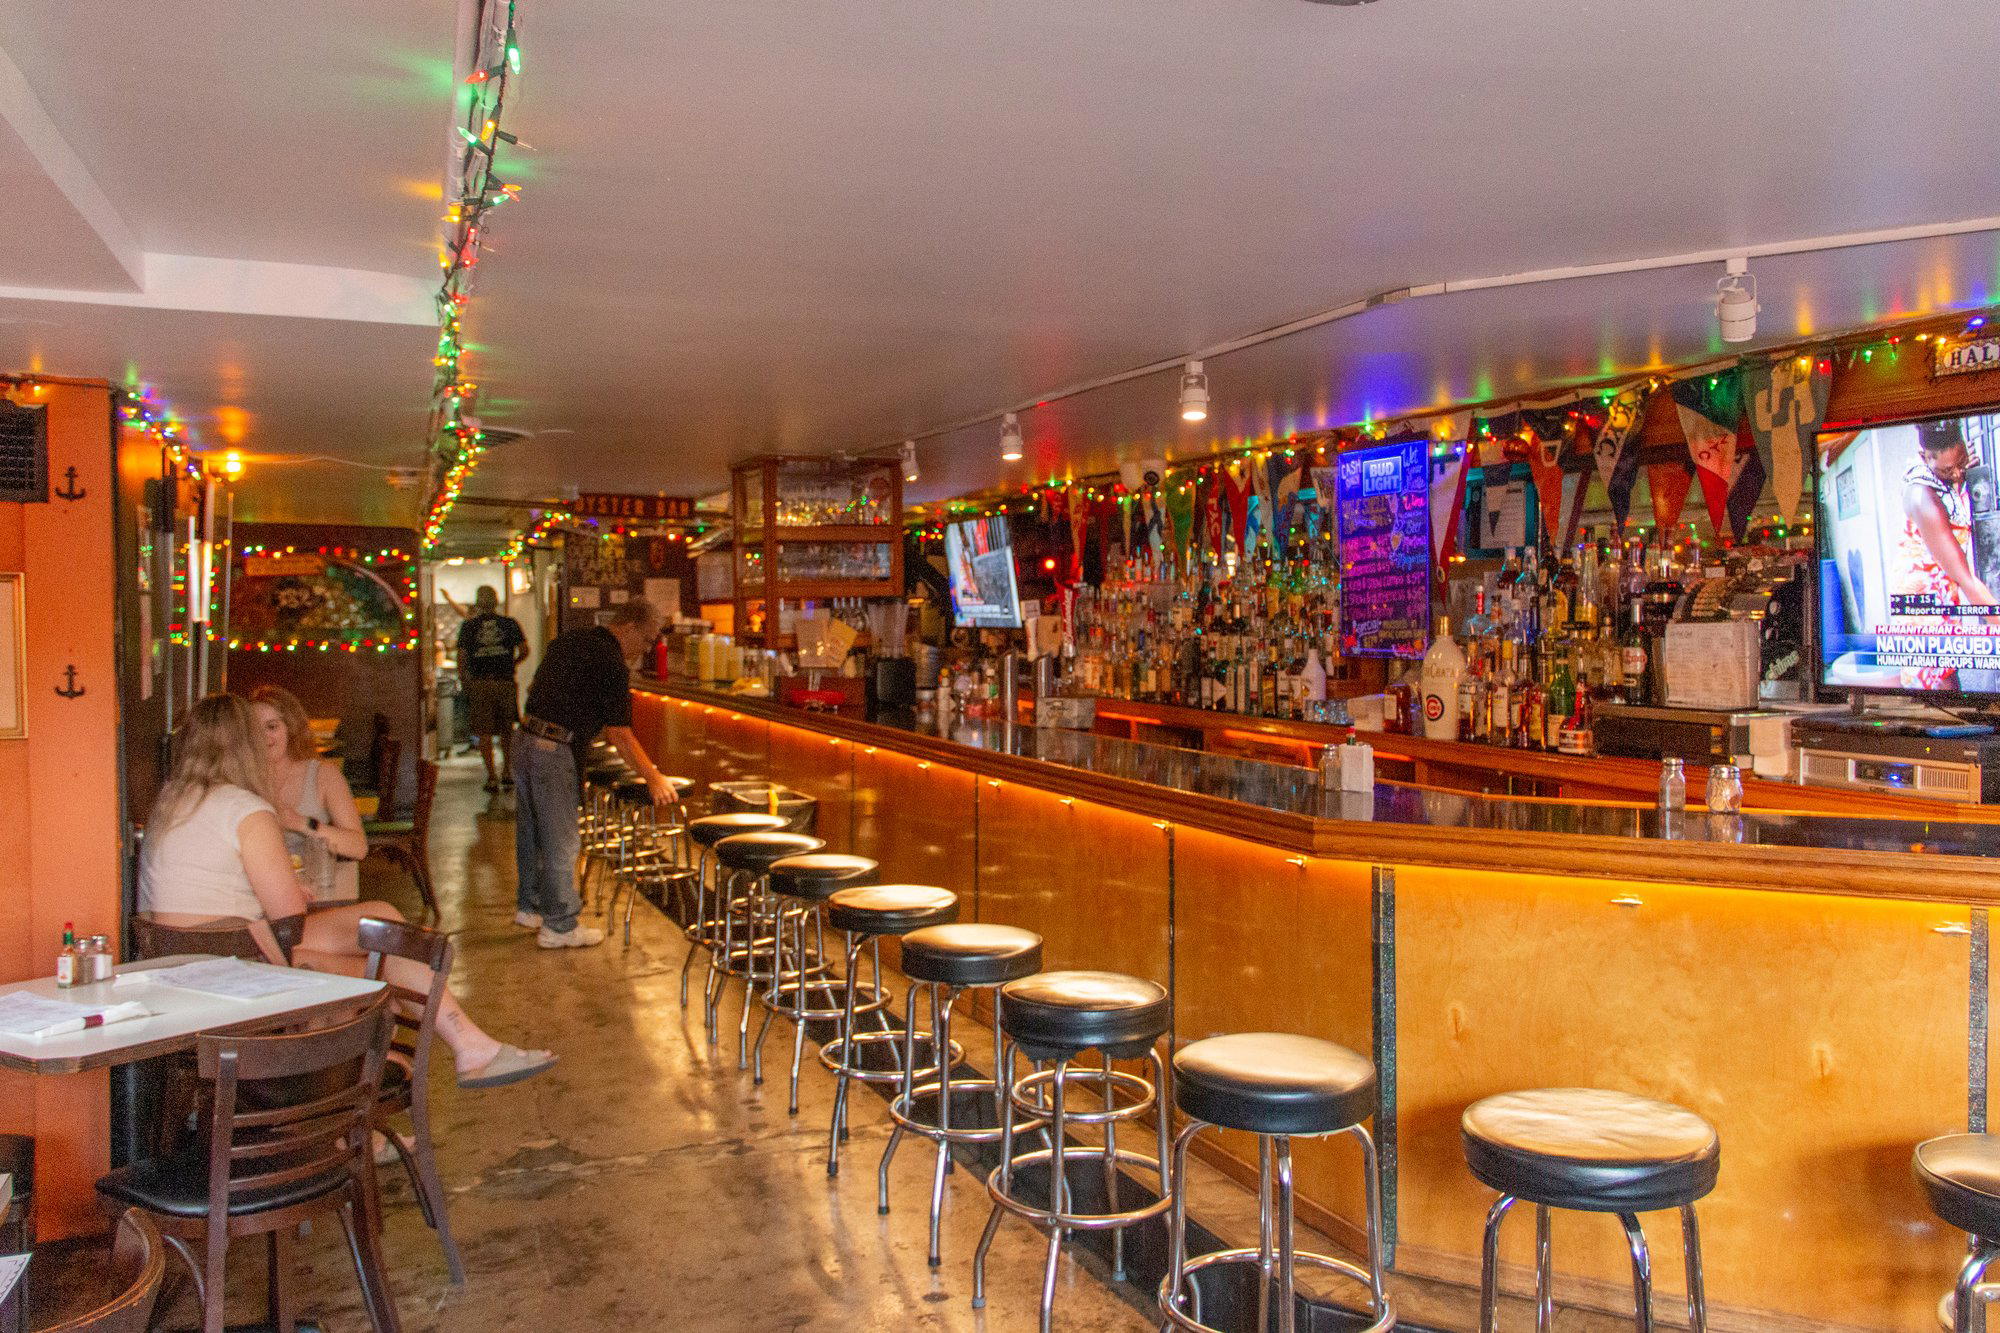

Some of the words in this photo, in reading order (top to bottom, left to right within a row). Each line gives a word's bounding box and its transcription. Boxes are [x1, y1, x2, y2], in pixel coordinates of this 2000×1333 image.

[1951, 345, 2000, 366] HAL
[1341, 458, 1362, 480] CASH
[1369, 461, 1395, 478] BUD
[1365, 475, 1400, 493] LIGHT
[574, 496, 645, 515] OYSTER
[656, 500, 690, 517] BAR
[1905, 595, 1916, 604] IT
[1905, 606, 1951, 615] Reporter:
[1956, 606, 1990, 615] TERROR
[1876, 625, 1953, 636] HUMANITARIAN
[1954, 625, 1987, 635] CRISIS
[1876, 636, 1927, 654] NATION
[1927, 637, 1993, 655] PLAGUED
[1877, 655, 1938, 668] HUMANITARIAN
[1938, 656, 1974, 668] GROUPS
